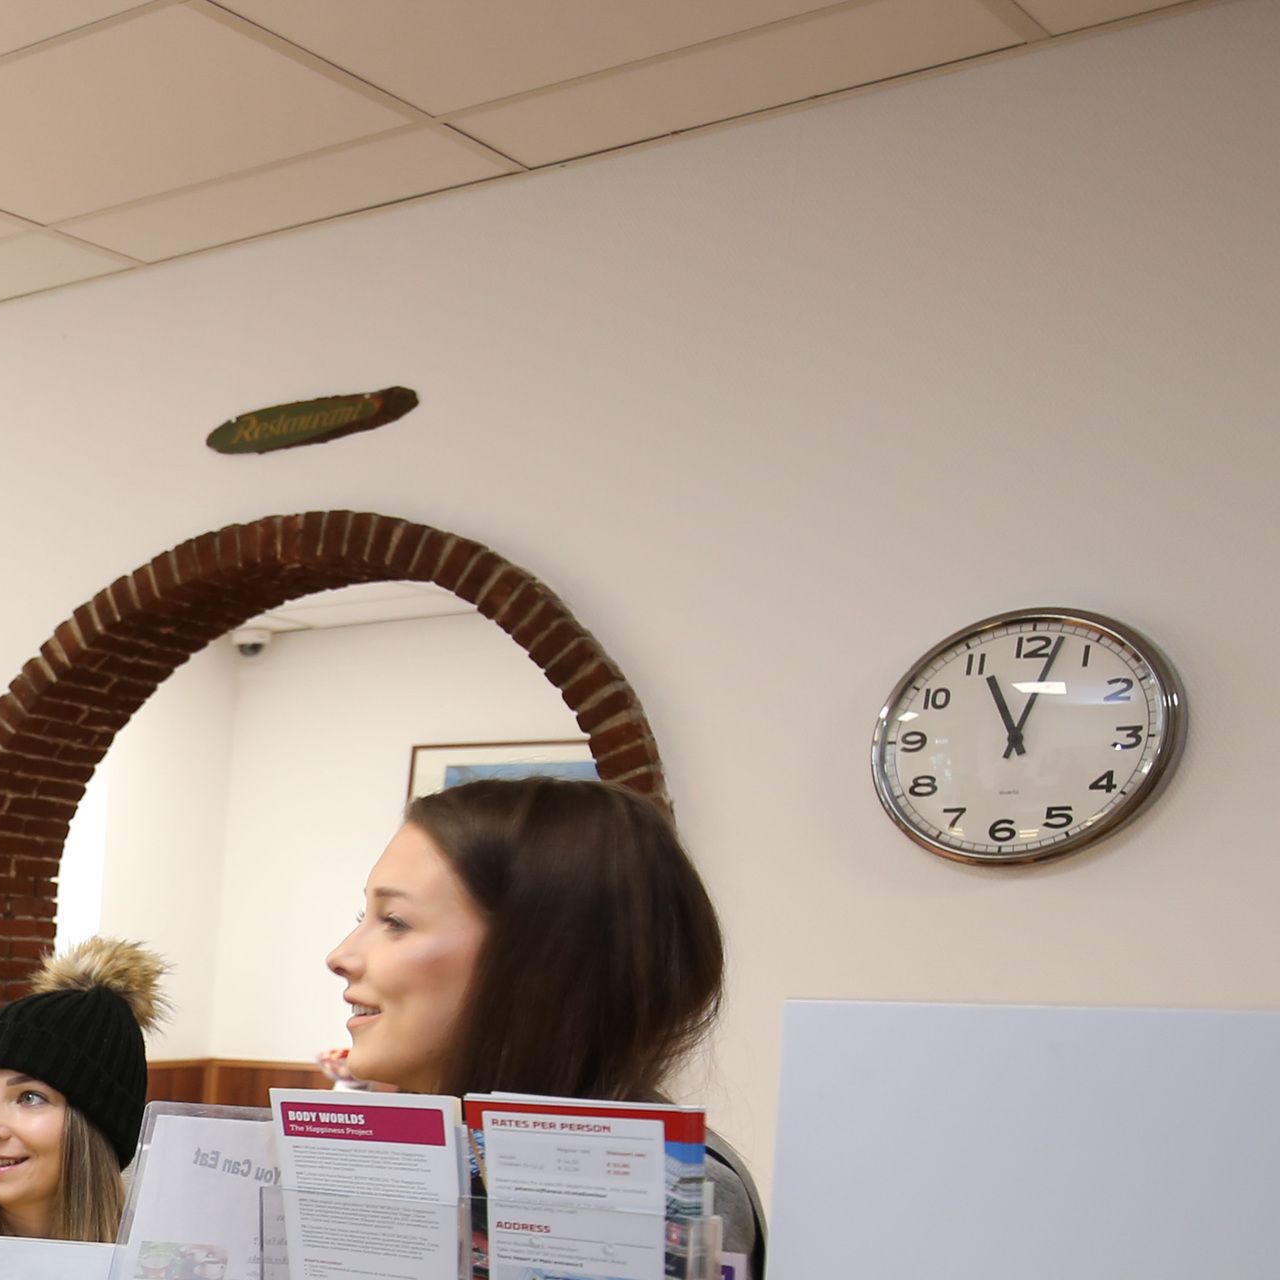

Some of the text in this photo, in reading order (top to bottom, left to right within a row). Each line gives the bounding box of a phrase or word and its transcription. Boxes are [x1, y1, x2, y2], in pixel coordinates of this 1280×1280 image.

[231, 402, 363, 444] Restaurant
[1015, 635, 1052, 659] 12
[1081, 644, 1091, 668] 1
[965, 653, 986, 676] 11
[922, 687, 951, 710] 10
[1103, 678, 1134, 702] 2
[900, 731, 928, 753] 9
[1111, 725, 1144, 750] 3
[908, 775, 938, 797] 8
[1088, 769, 1117, 794] 4
[942, 807, 967, 828] 7
[1042, 806, 1073, 829] 5
[988, 819, 1016, 842] 6
[288, 1110, 365, 1125] BODY WORLDS
[491, 1117, 612, 1133] RATES PER PERSON
[290, 1124, 373, 1136] The Happiness Project
[495, 1220, 551, 1234] ADDRESS
